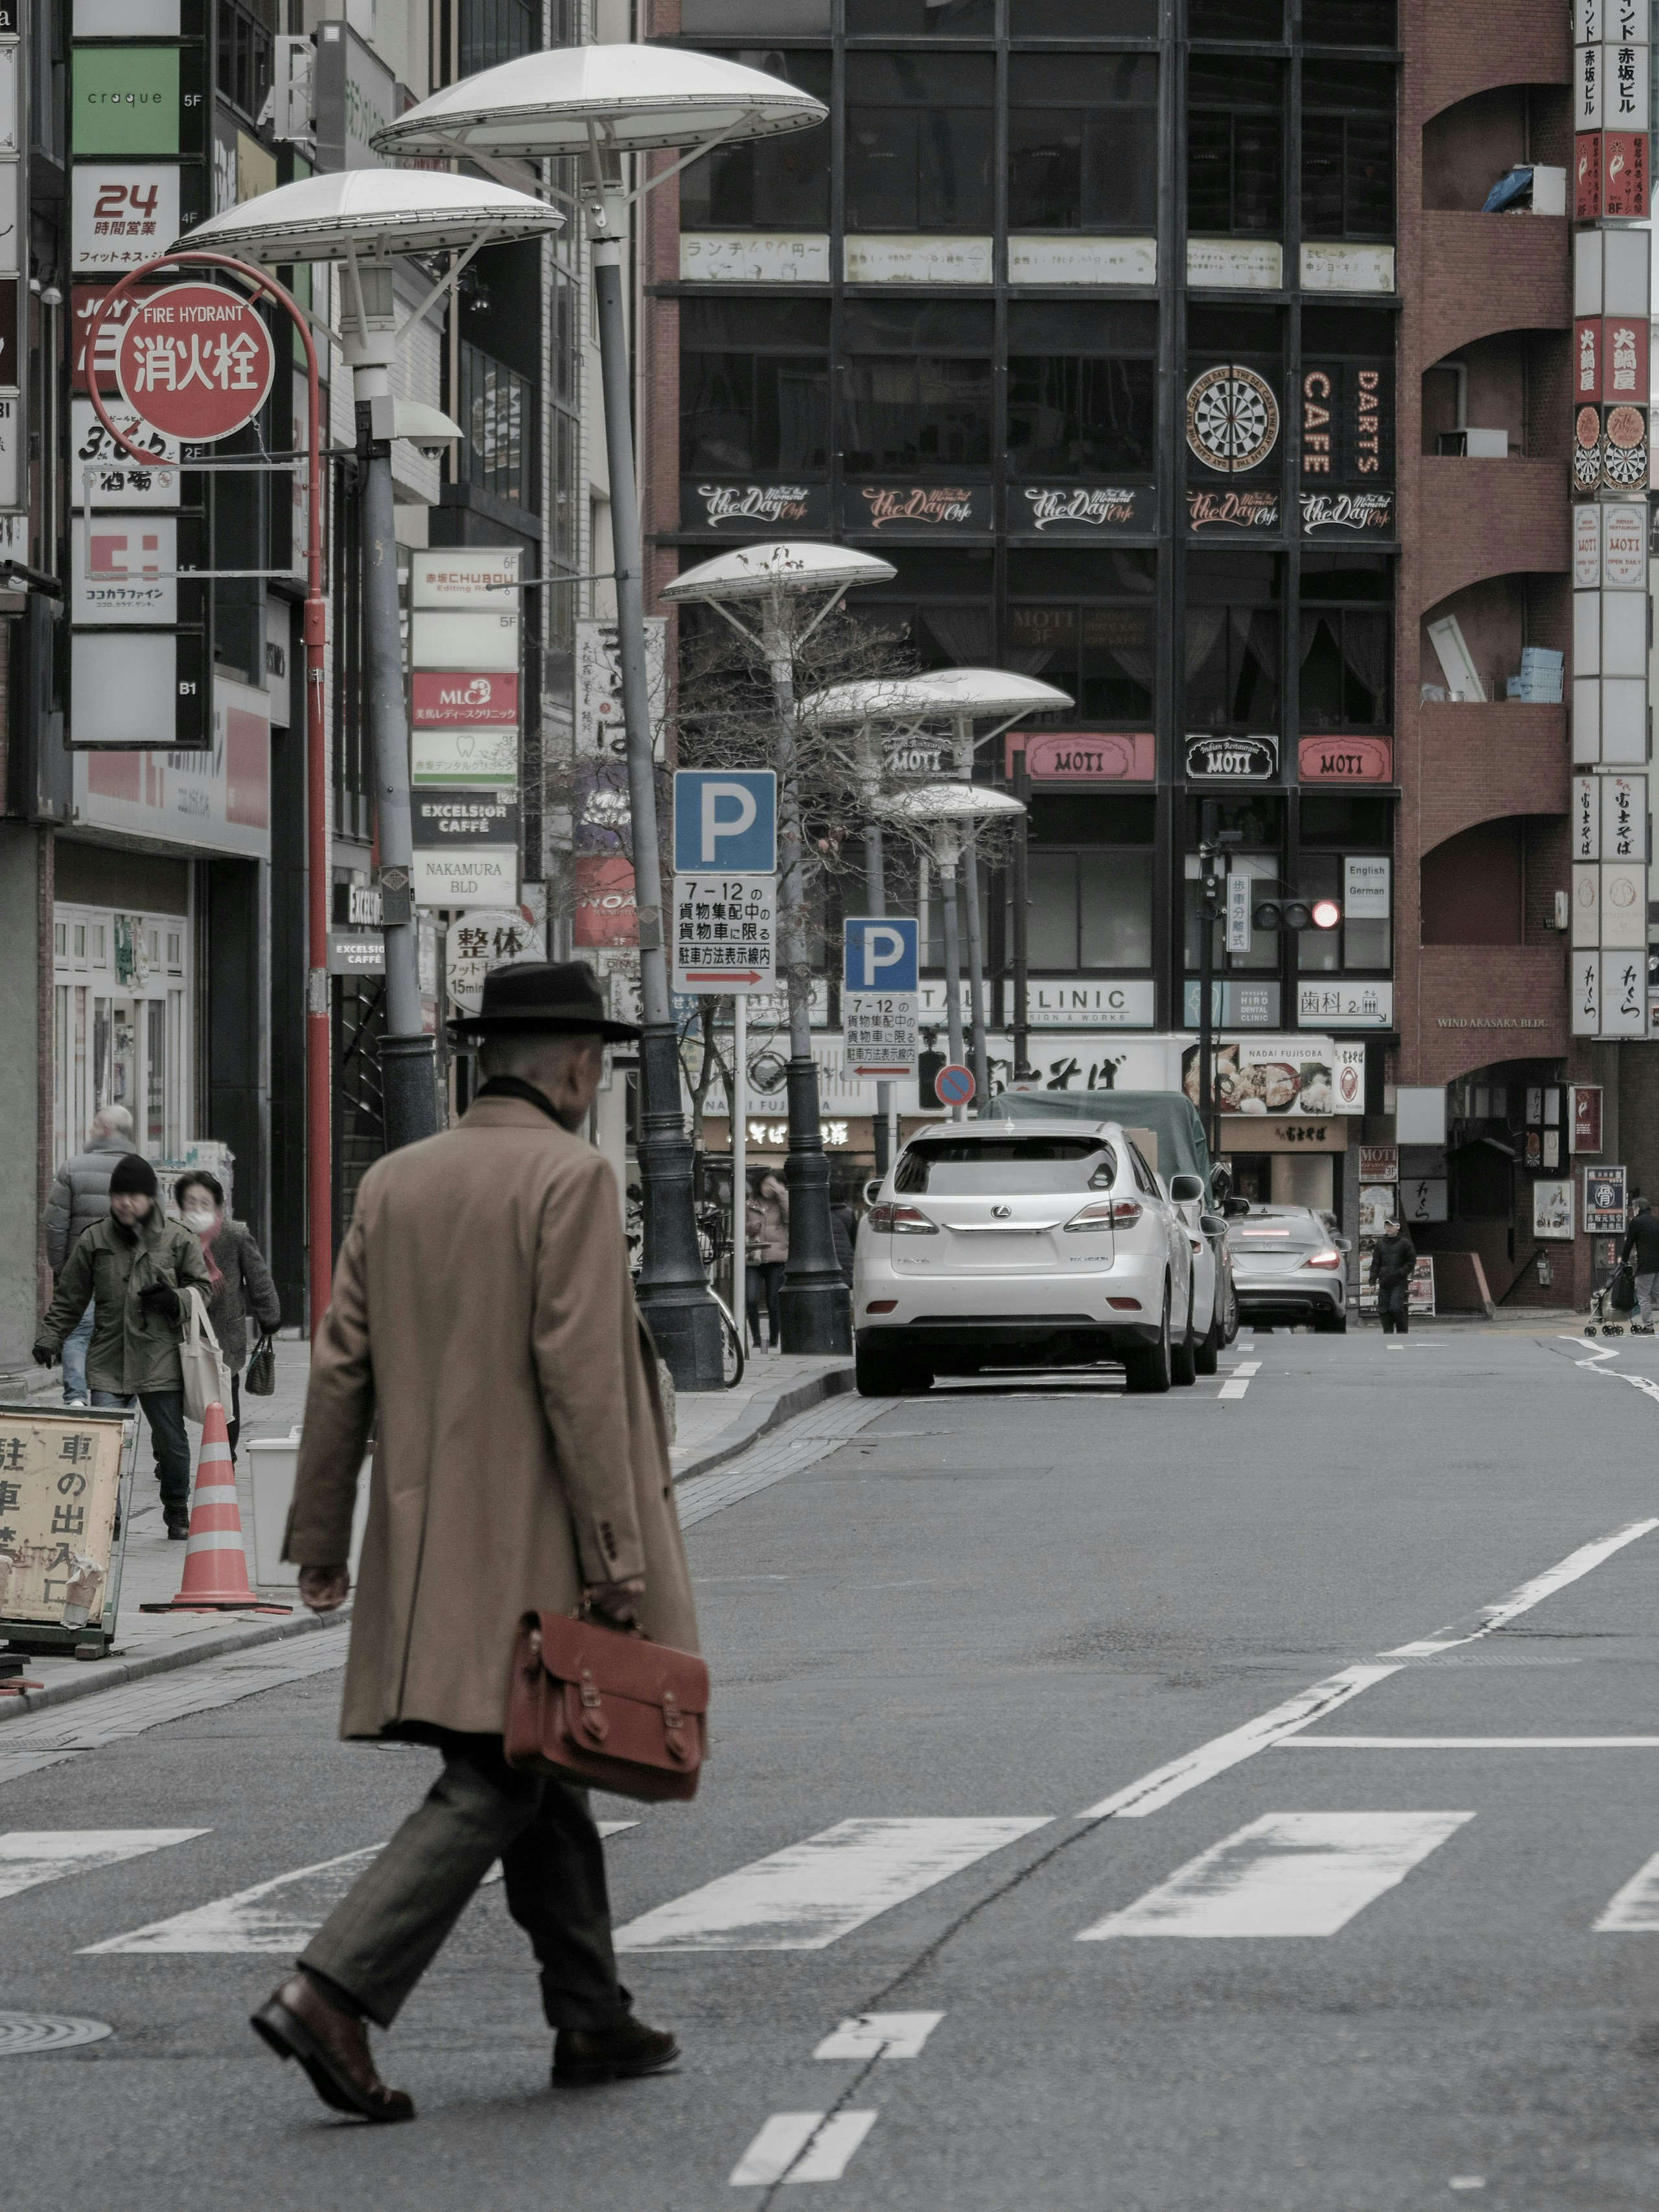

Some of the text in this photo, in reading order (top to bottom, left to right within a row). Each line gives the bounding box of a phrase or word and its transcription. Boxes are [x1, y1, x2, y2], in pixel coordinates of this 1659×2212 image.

[1584, 50, 1595, 116] 赤坂ビル
[1618, 48, 1636, 113] 赤坂ビル
[88, 91, 162, 106] craque
[184, 95, 202, 107] 5F
[93, 185, 158, 218] 24
[1608, 202, 1622, 214] 8F
[181, 213, 198, 224] 4F
[94, 221, 156, 236] 時間営業
[80, 251, 164, 263] フィットネス・ジ
[143, 305, 244, 323] FIRE HYDRANT
[133, 332, 259, 393] 消火栓
[1580, 329, 1595, 391] 火鍋屋
[1613, 329, 1637, 390] 火鍋屋
[1303, 371, 1330, 473] CAFE
[1358, 371, 1379, 473] DARTS
[184, 448, 202, 459] 2F
[765, 487, 809, 501] Moment
[928, 490, 971, 503] Moment
[1091, 491, 1136, 507] Moment
[1240, 493, 1279, 506] Moment
[697, 485, 807, 522] The Day Cafe
[862, 488, 972, 523] The Day Cafe
[1025, 489, 1134, 524] The Day Cafe
[1187, 491, 1279, 526] The Day Cafe
[1353, 495, 1393, 509] Moment
[1299, 494, 1391, 529] The Day Cafe
[1578, 539, 1597, 552] MOTI
[1609, 538, 1640, 552] MOTI
[504, 557, 516, 569] 6F
[86, 588, 163, 600] ココカラファイン
[500, 616, 516, 627] 5F
[180, 683, 196, 695] B1
[439, 690, 477, 705] MLC
[415, 709, 516, 719] 美馬レディースクリニック
[1200, 742, 1259, 754] Indian Restaurant
[1054, 752, 1104, 772] MOTI
[1207, 753, 1252, 774] MOTI
[1321, 755, 1363, 774] MOTI
[422, 805, 507, 818] EXCELSIOR
[439, 818, 489, 833] CAFFÉ
[702, 783, 757, 862] P
[1581, 793, 1592, 856] 富士そば
[1615, 792, 1634, 856] 富士そば
[426, 863, 502, 876] NAKAMURA
[1350, 866, 1385, 876] English
[450, 881, 478, 894] BLD
[1350, 887, 1384, 896] German
[679, 903, 771, 921] 貨物集配中の
[1233, 880, 1246, 947] 歩車分離式
[679, 923, 771, 940] 貨物車に限る
[336, 945, 386, 954] EXCELSIO
[458, 927, 524, 960] 整体
[347, 955, 382, 964] CAFFÉ
[679, 947, 771, 965] 駐車方法表示線内
[864, 927, 905, 986] P
[1300, 991, 1361, 1014] 歯科 2F
[847, 1015, 915, 1029] 貨物集配中の
[1437, 1019, 1467, 1028] WIND
[1470, 1018, 1518, 1028] AKASAKA
[847, 1030, 915, 1043] 貨物車に限る
[847, 1048, 915, 1061] 駐車方法表示線内
[1361, 1149, 1397, 1161] MOTI
[1386, 1167, 1396, 1176] 3F
[1597, 1186, 1613, 1205] 骨
